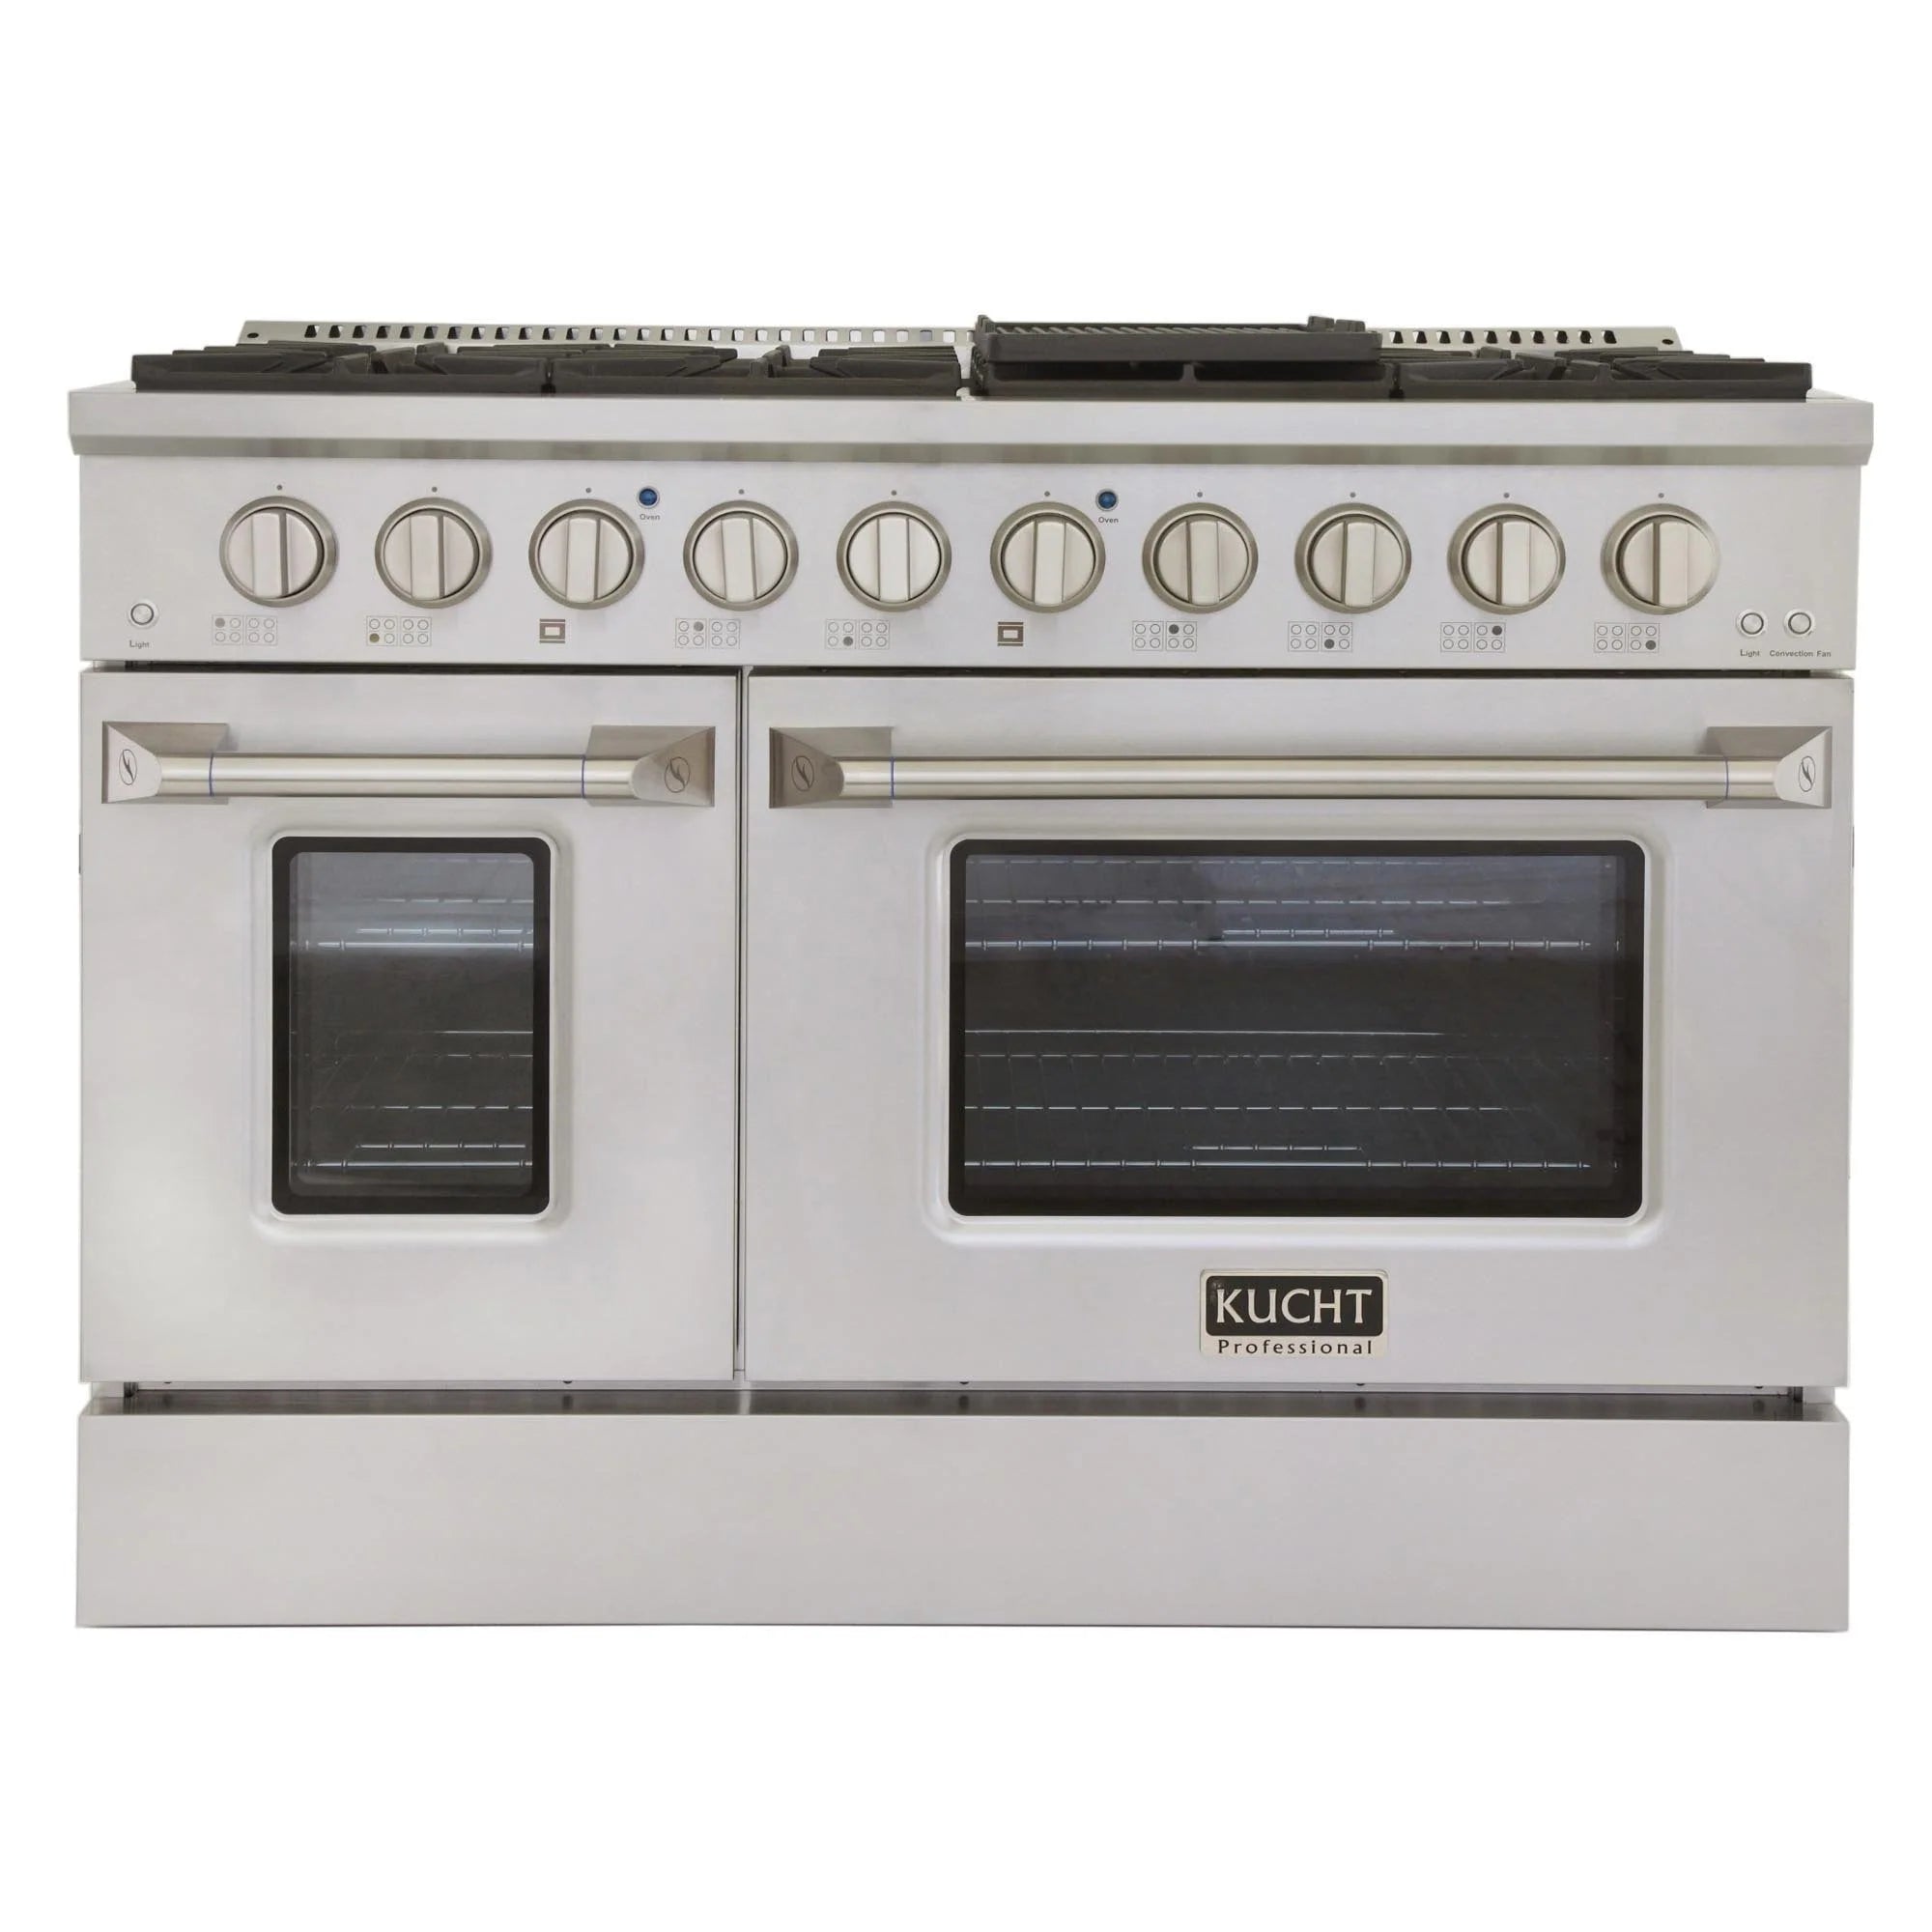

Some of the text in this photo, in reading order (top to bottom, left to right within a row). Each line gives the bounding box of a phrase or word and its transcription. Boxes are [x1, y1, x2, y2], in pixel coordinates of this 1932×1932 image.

[128, 639, 150, 650] Light
[1740, 649, 1760, 658] Light
[1769, 649, 1814, 658] Convection
[1216, 1288, 1373, 1324] KUCHT
[1218, 1339, 1372, 1354] Professional
